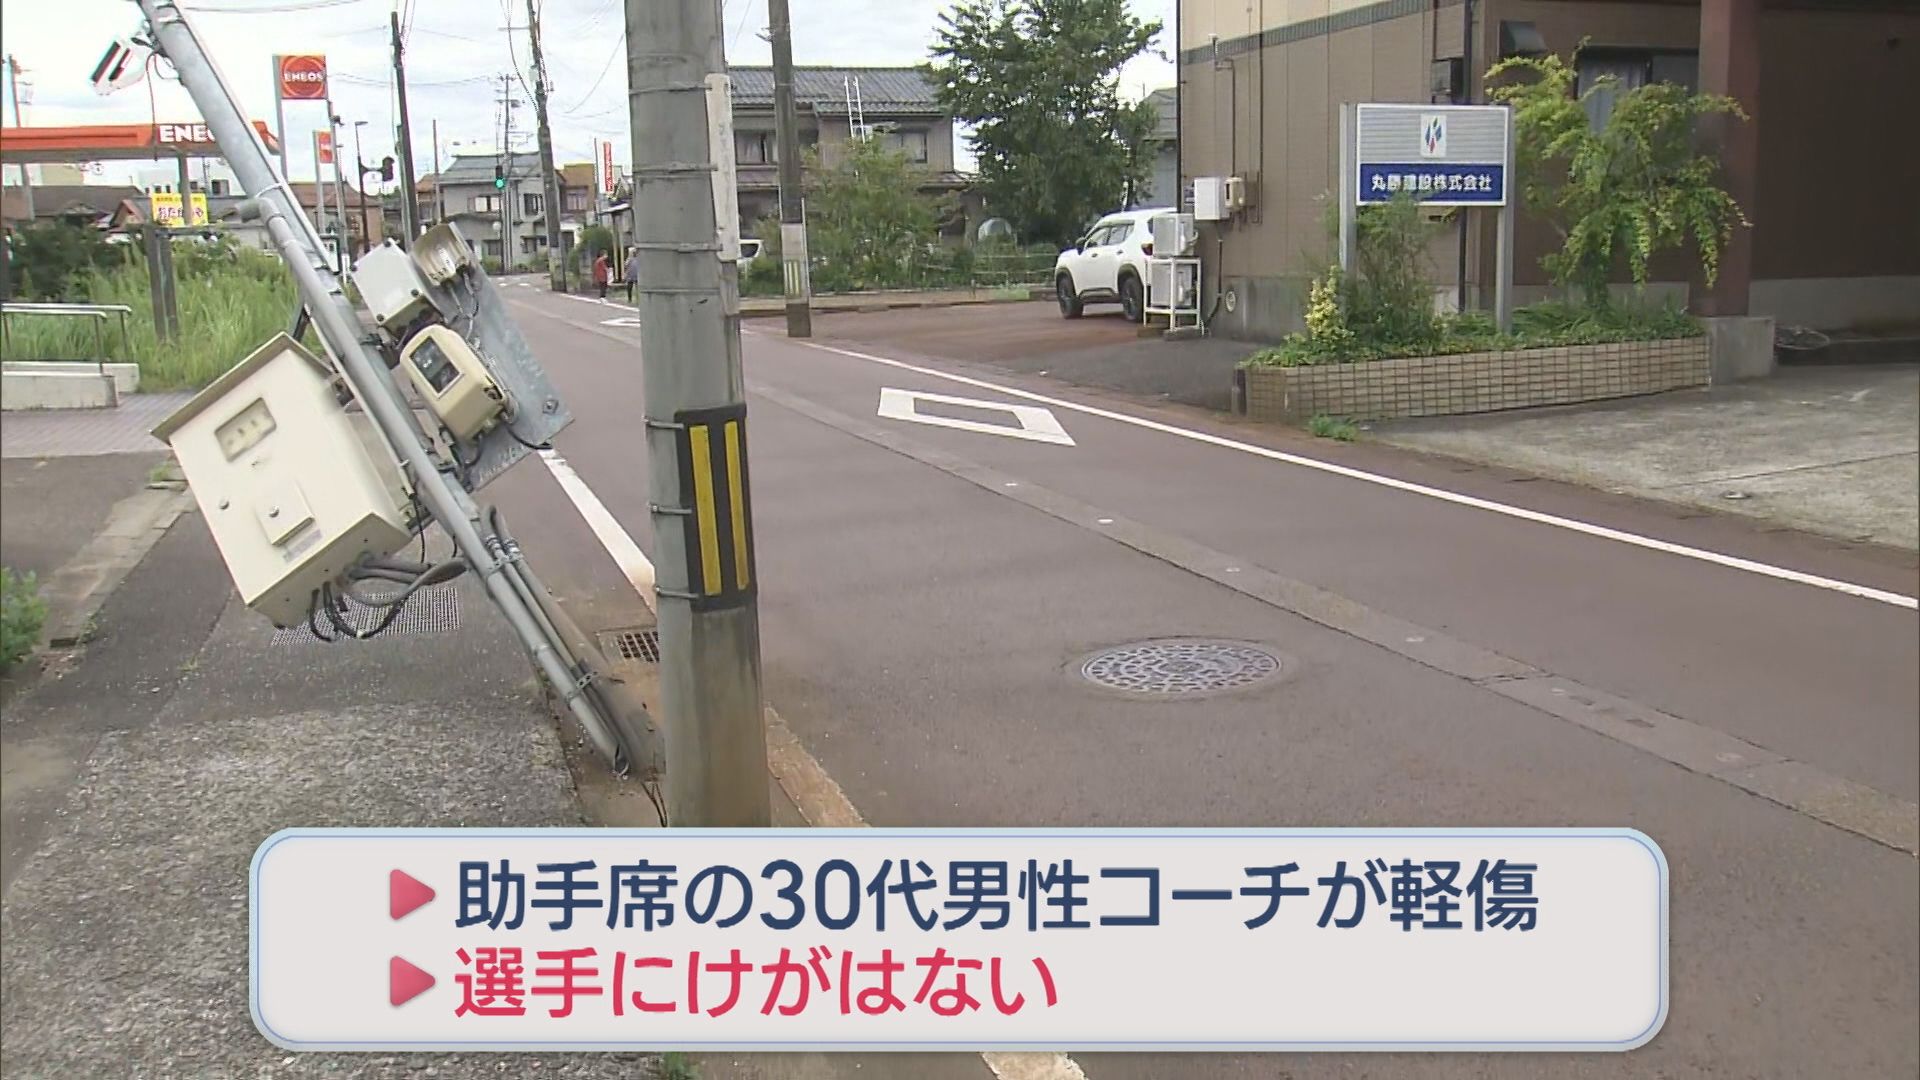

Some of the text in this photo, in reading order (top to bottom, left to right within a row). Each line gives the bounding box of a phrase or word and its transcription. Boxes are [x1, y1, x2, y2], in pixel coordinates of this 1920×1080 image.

[284, 72, 324, 81] ENEOS
[1371, 174, 1492, 192] 丸勝建設株式会社
